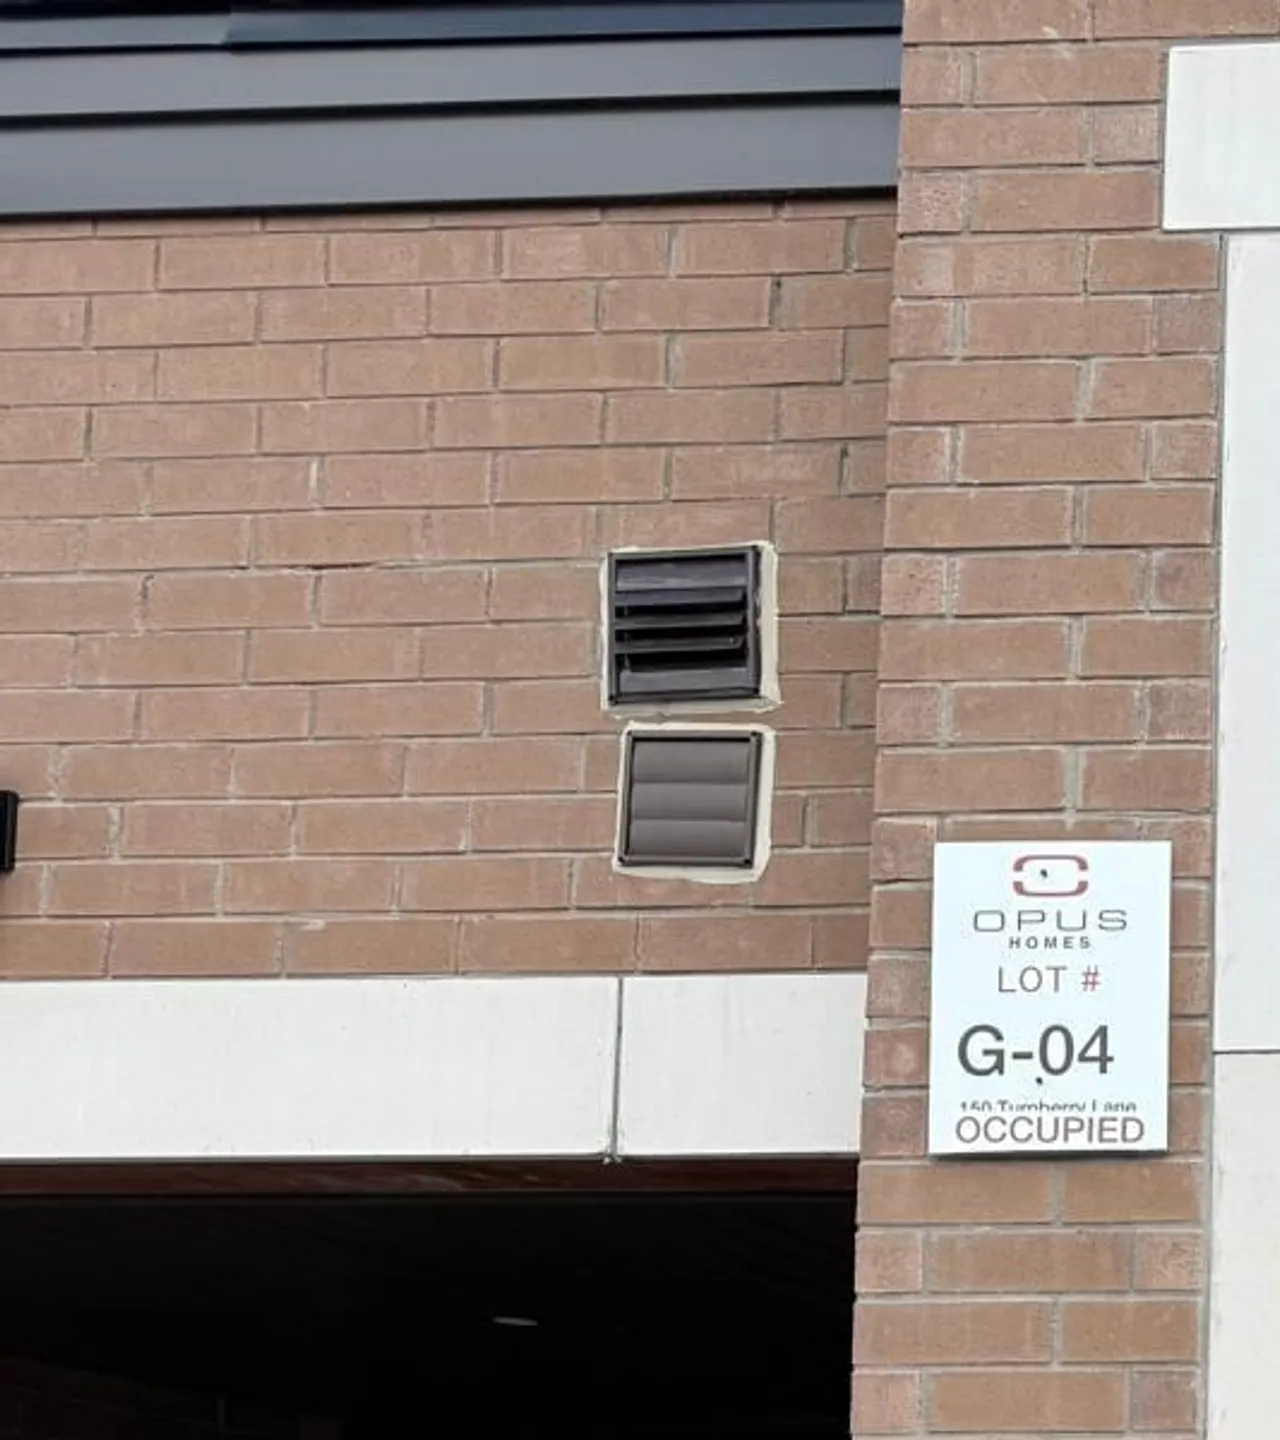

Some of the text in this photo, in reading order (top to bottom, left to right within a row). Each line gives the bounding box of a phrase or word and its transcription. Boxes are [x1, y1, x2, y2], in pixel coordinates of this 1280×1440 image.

[973, 909, 1127, 932] OPUS
[1008, 936, 1091, 950] HOMES
[998, 964, 1101, 993] LOT #
[957, 1024, 1115, 1077] G-04
[955, 1115, 1145, 1144] OCCUPIED
